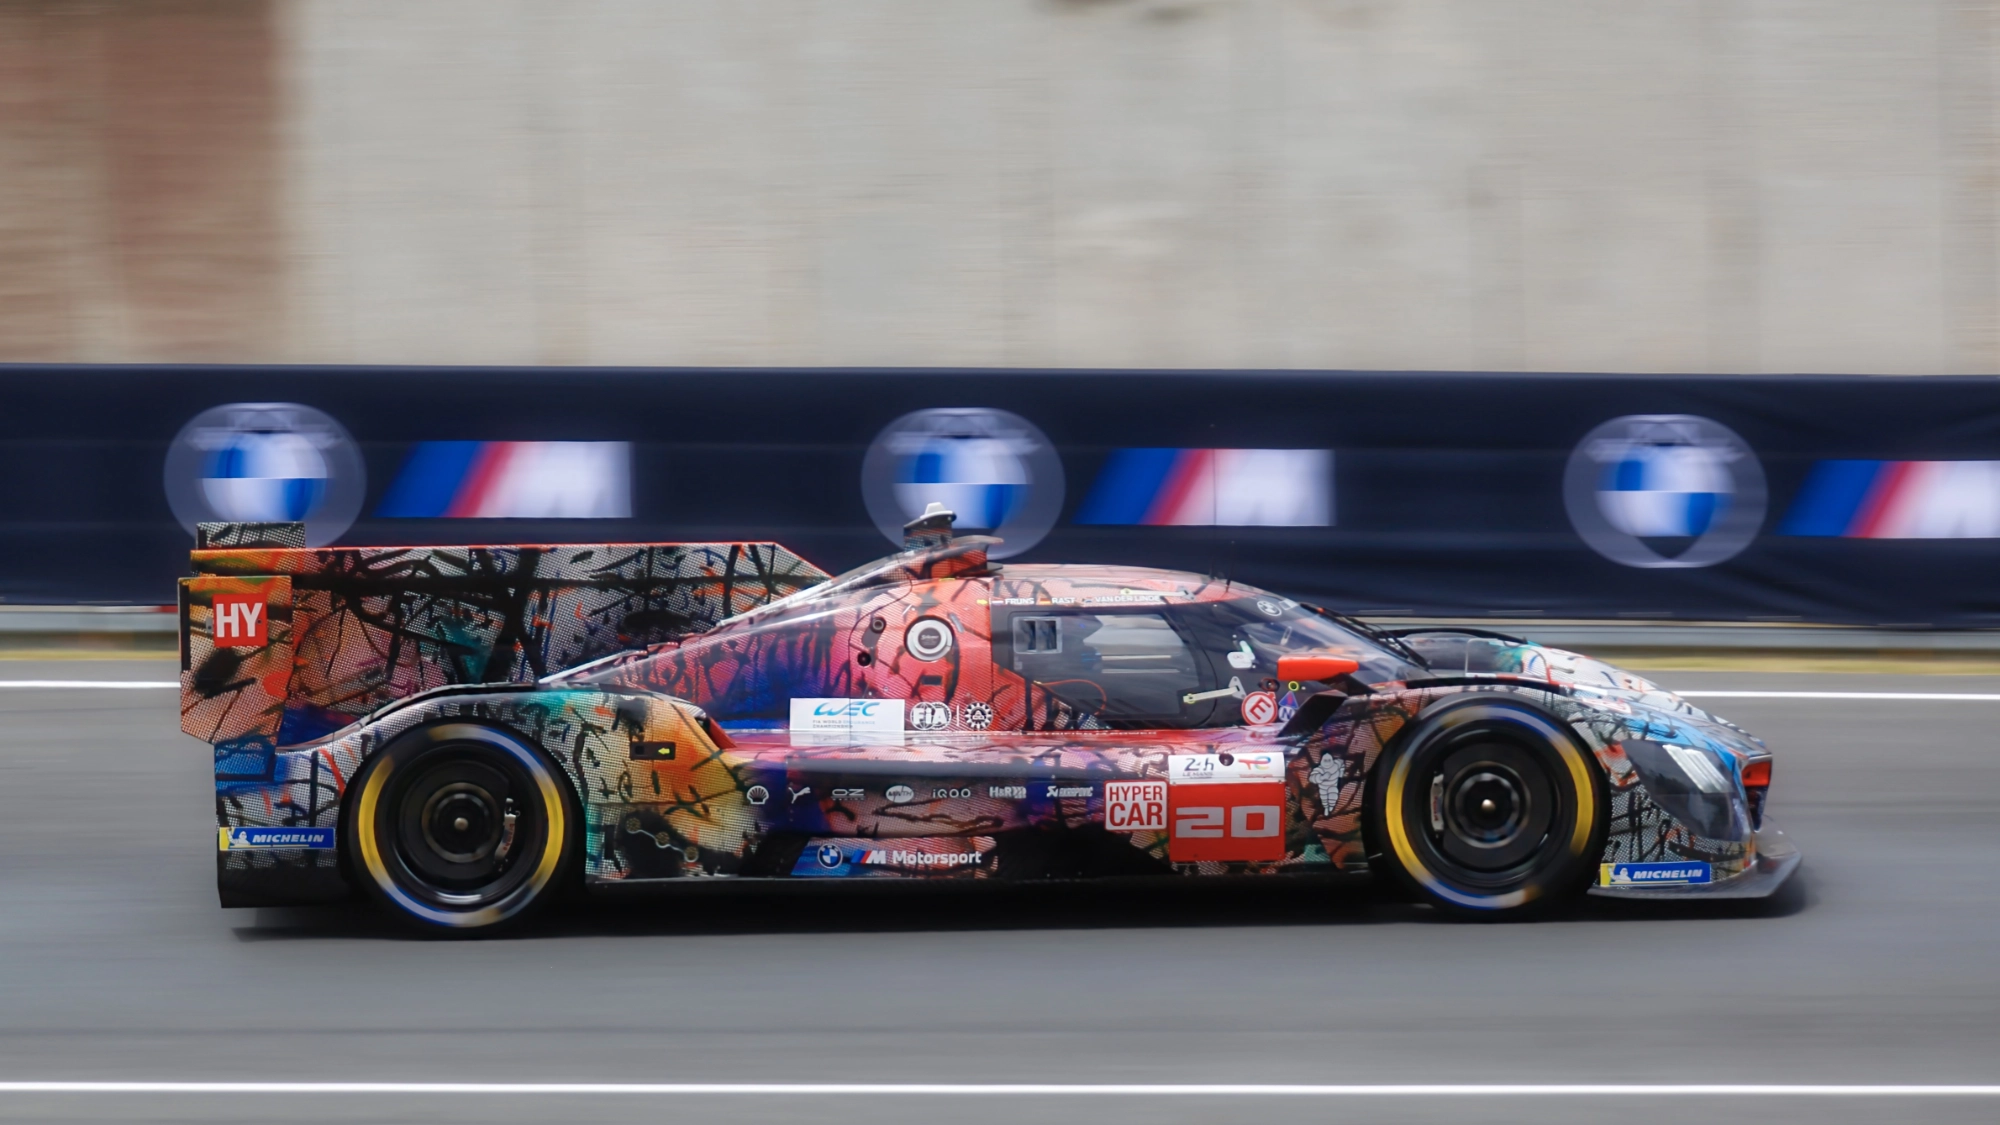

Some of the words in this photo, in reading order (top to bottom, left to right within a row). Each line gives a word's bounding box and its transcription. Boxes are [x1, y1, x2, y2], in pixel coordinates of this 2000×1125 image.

[216, 603, 263, 637] HY
[813, 701, 881, 717] WEC
[1249, 697, 1271, 720] E
[1109, 786, 1163, 801] HYPER
[1109, 802, 1163, 826] CAR
[1175, 806, 1281, 838] 20
[252, 834, 324, 843] MICHELIN
[893, 851, 982, 866] Motorsport
[1633, 869, 1703, 879] MICHELIN
